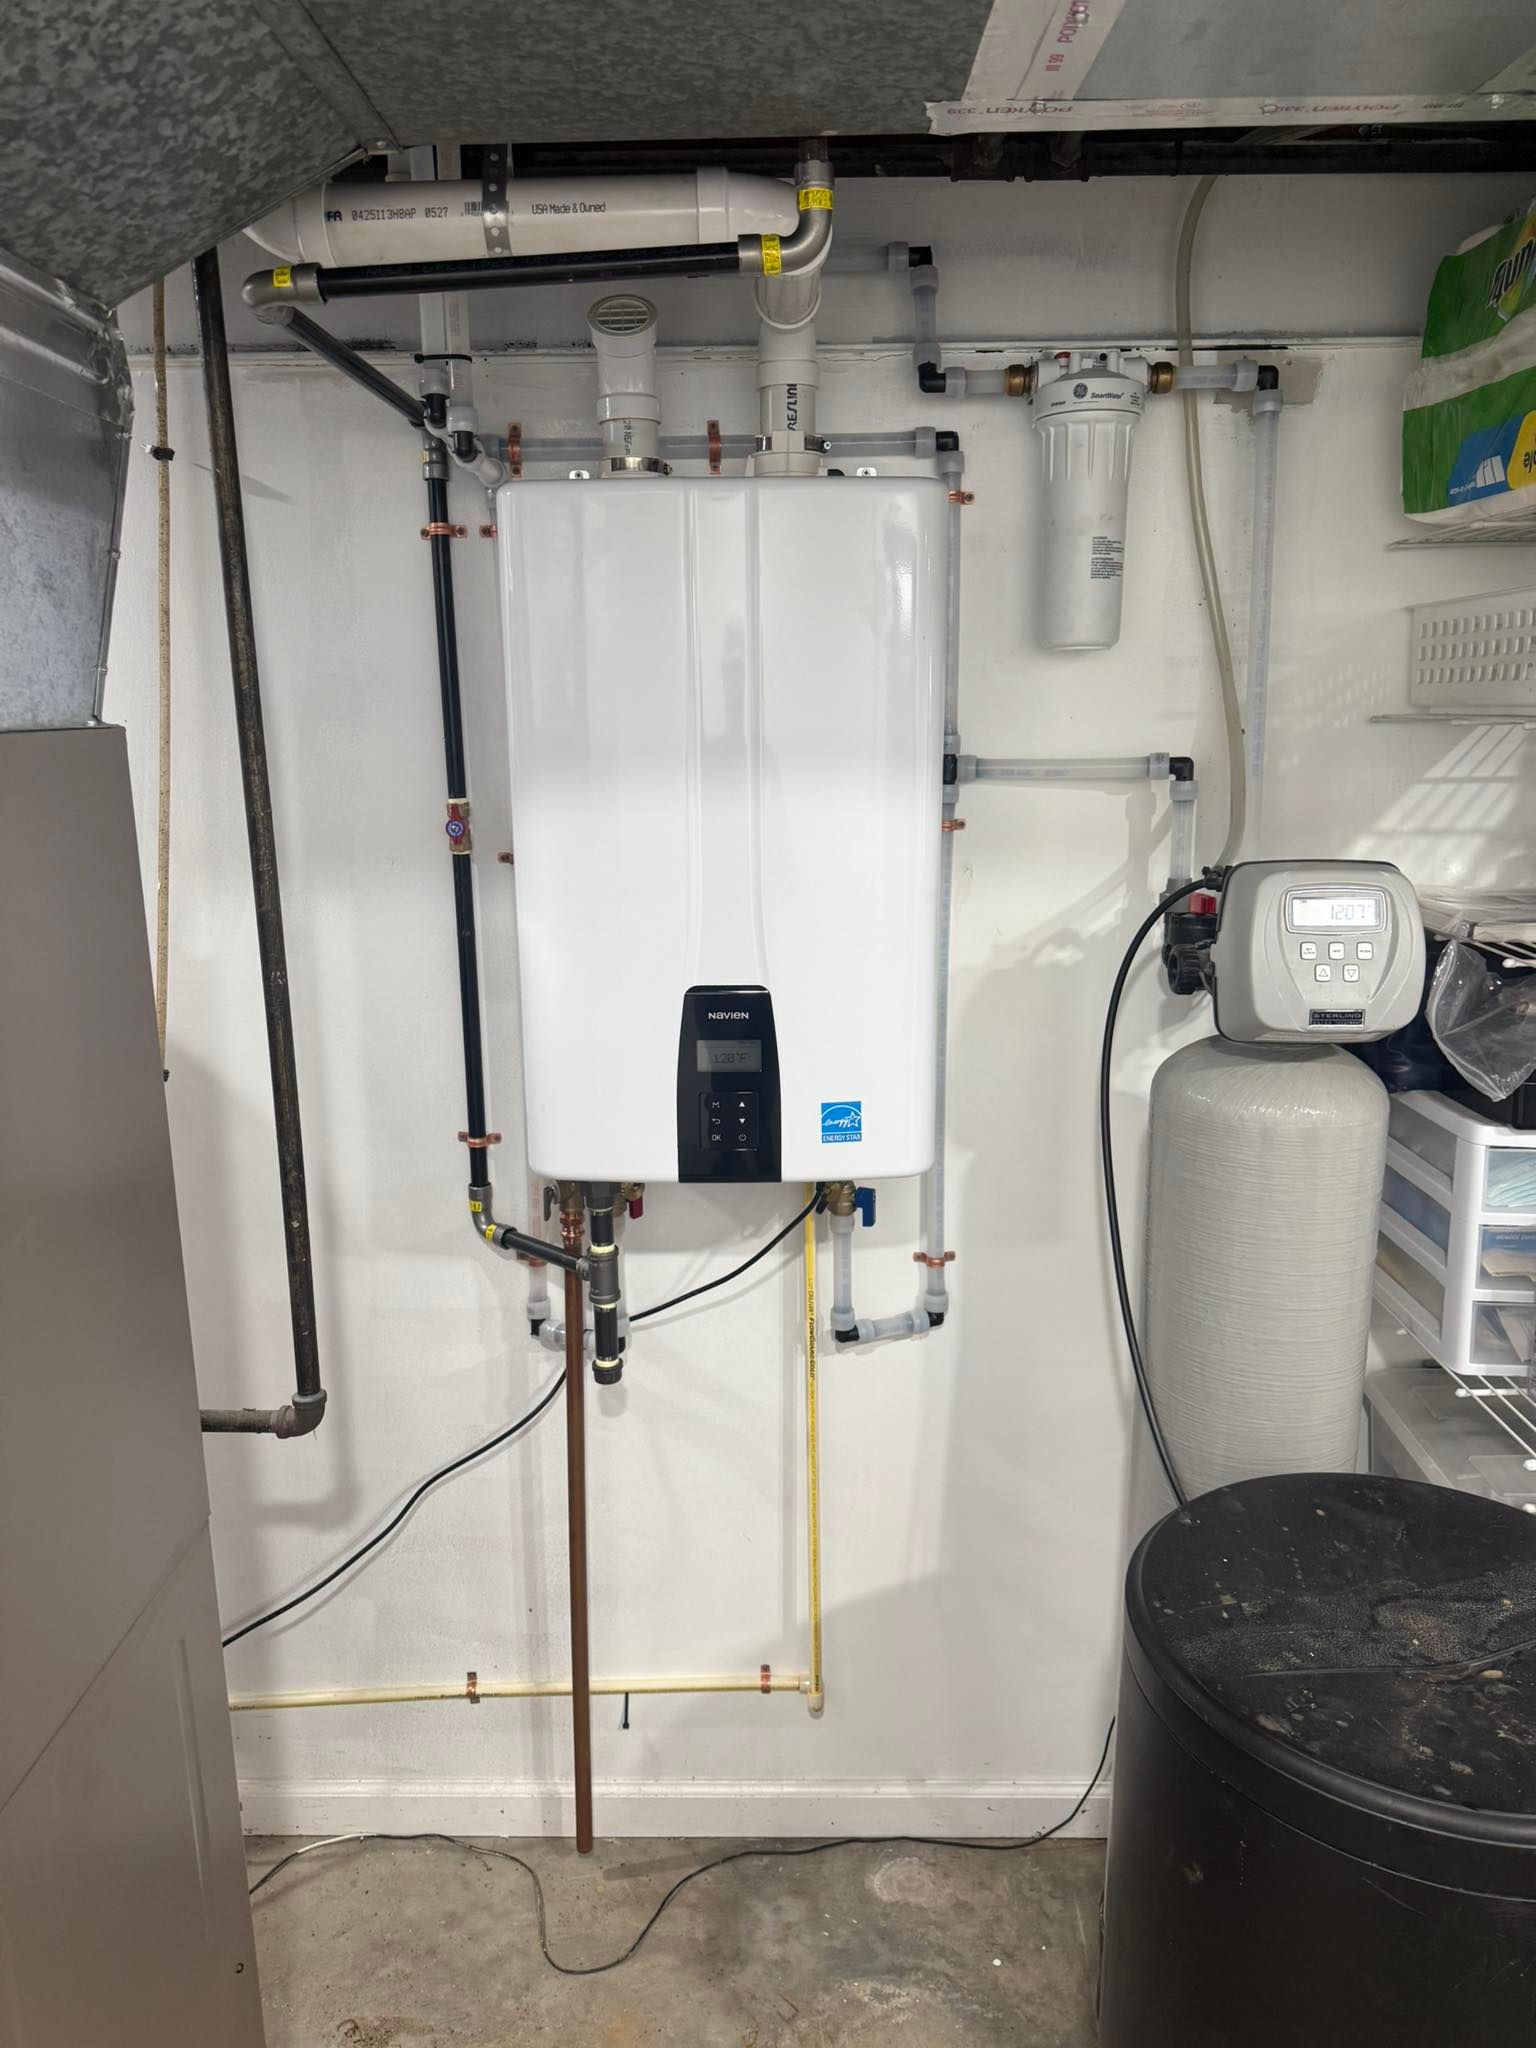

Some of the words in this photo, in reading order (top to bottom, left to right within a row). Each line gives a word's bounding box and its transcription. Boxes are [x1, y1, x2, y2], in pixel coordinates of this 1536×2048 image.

[531, 203, 549, 215] USA
[550, 202, 570, 214] Made
[572, 202, 578, 214] &
[579, 201, 606, 213] Owned
[711, 1133, 721, 1142] OK
